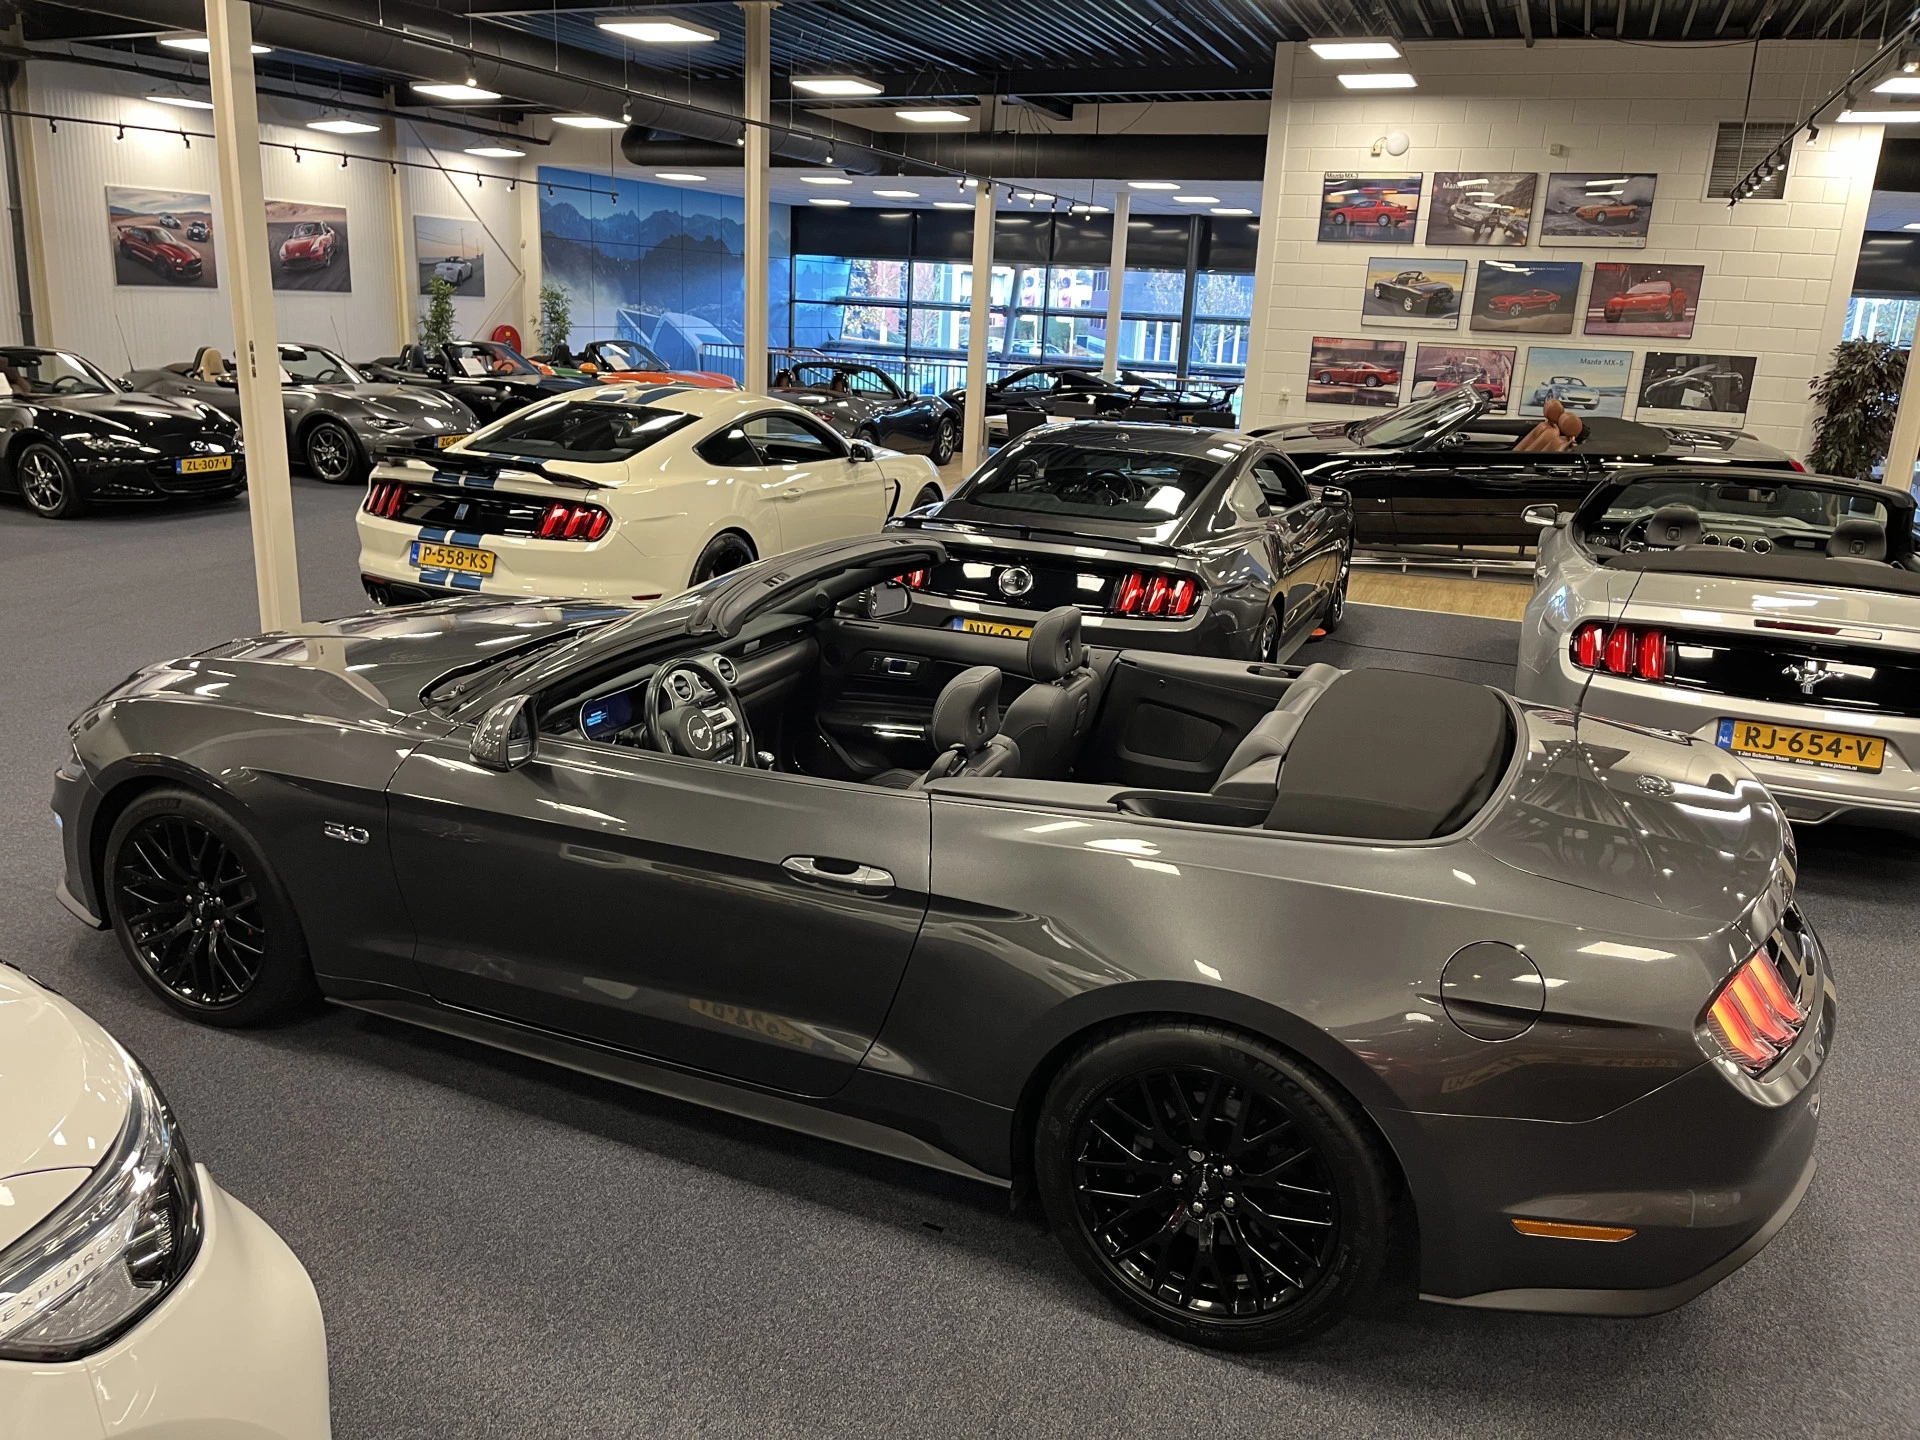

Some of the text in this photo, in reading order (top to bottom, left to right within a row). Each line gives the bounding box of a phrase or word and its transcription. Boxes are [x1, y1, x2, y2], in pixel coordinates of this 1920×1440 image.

[1604, 359, 1625, 367] MX-5
[186, 458, 228, 471] ZL-307-V
[423, 547, 489, 569] P-558-KS
[1719, 735, 1730, 744] NL
[1744, 726, 1873, 762] RJ-654-V
[323, 820, 370, 845] 5.0
[1, 1230, 121, 1322] EXPLORER
